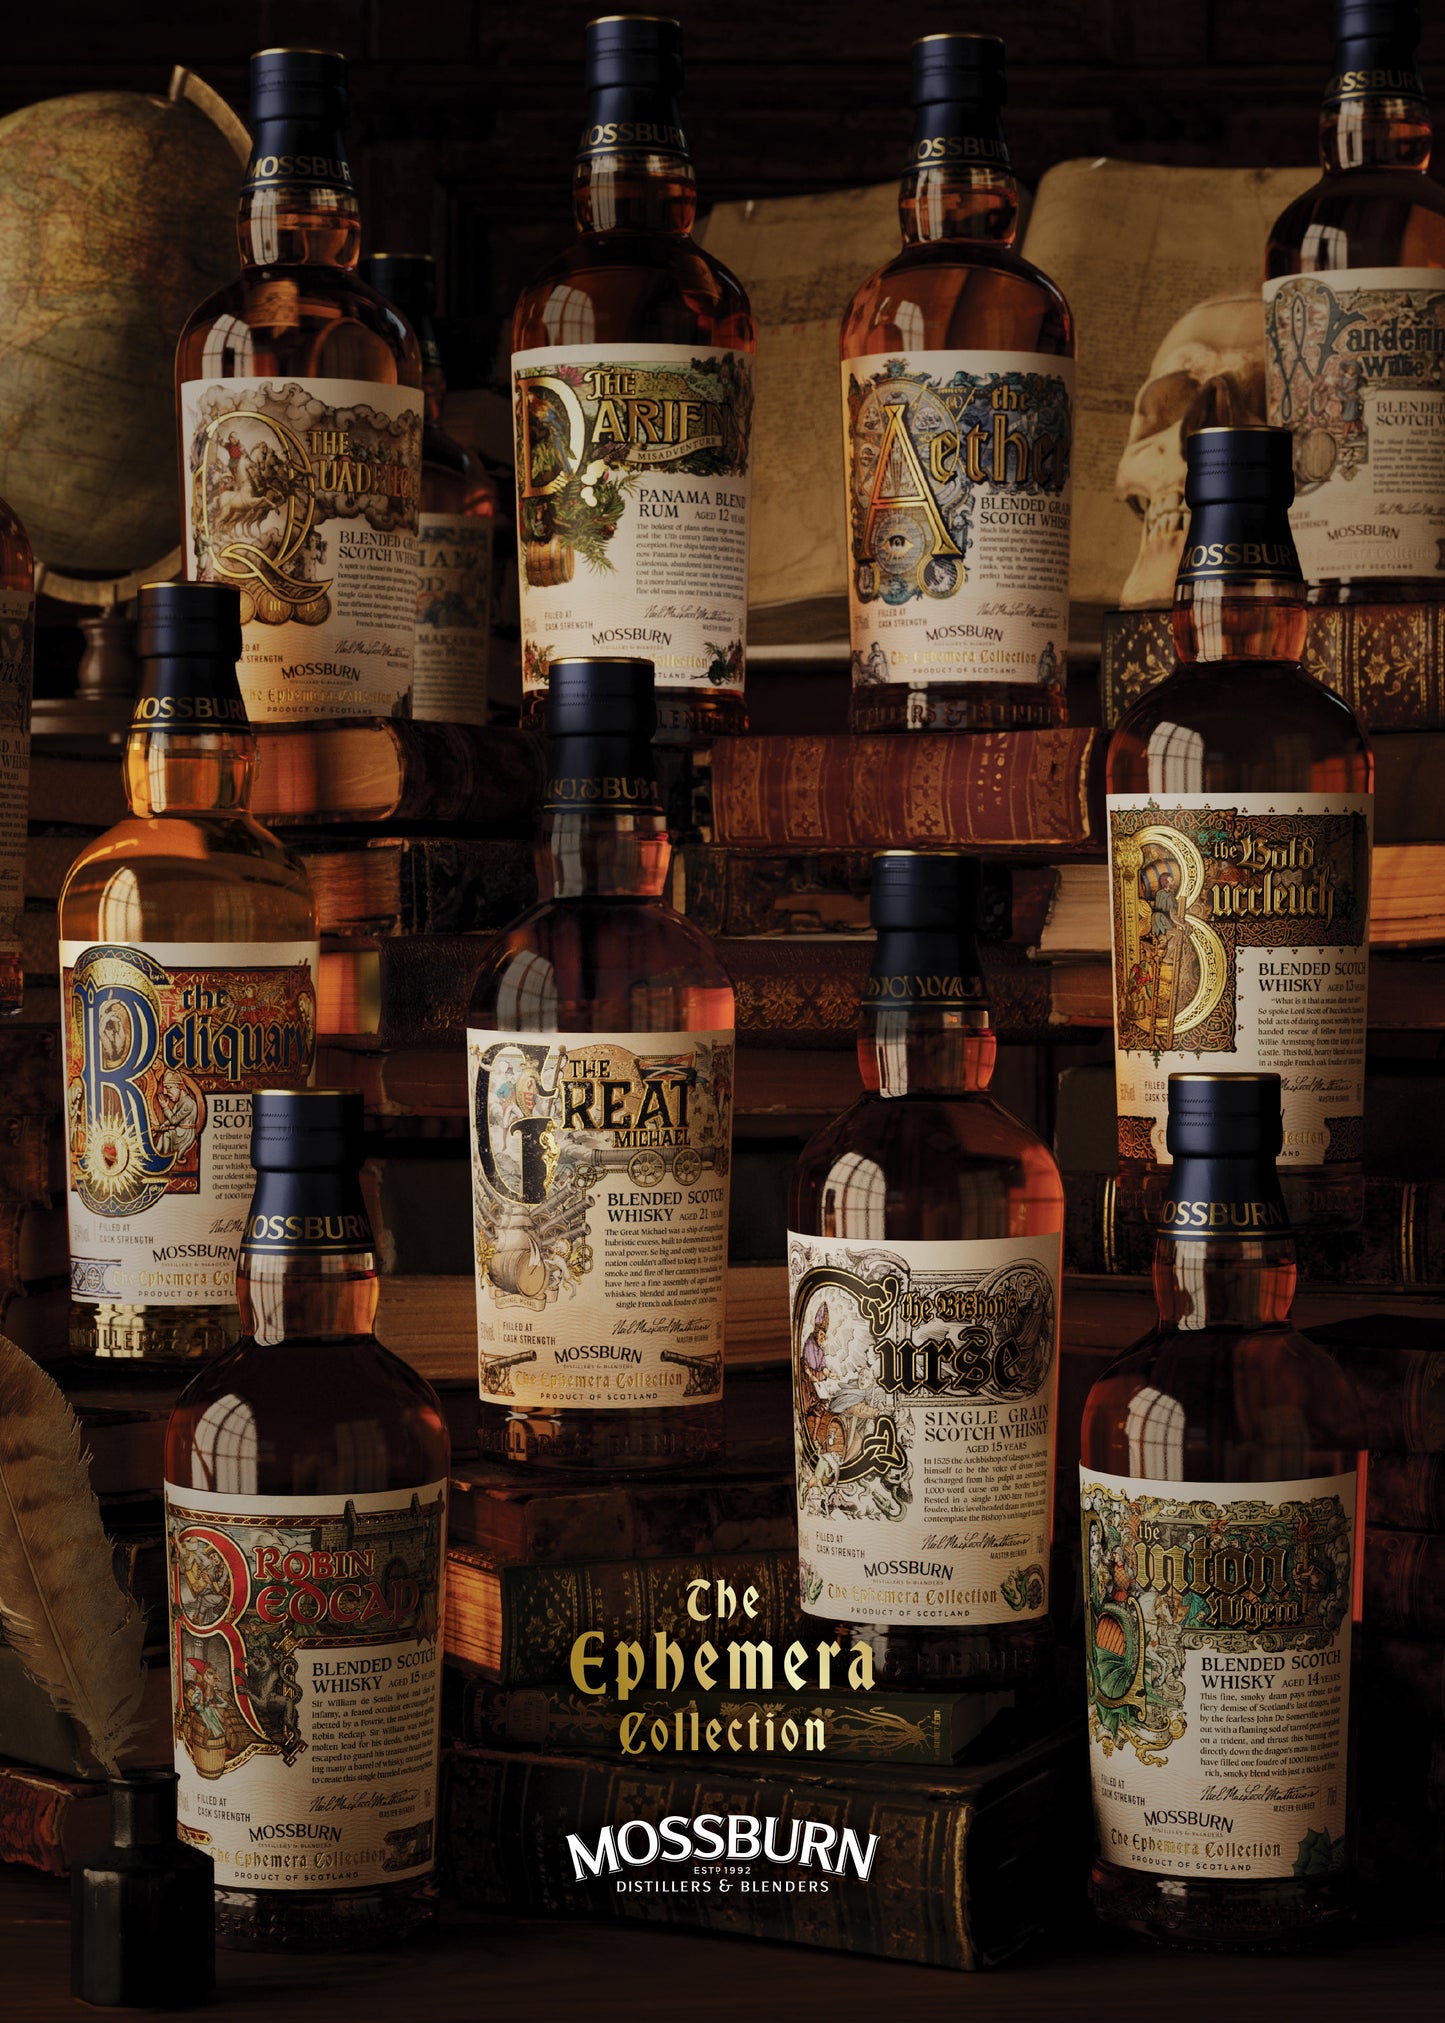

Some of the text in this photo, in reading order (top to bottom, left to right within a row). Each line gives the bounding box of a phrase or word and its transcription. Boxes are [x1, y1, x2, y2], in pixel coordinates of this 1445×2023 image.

[585, 370, 635, 399] THE
[992, 386, 1029, 410] the
[1376, 414, 1432, 426] SCOTCH
[308, 431, 349, 455] THE
[638, 437, 717, 462] MISADVENTURE
[639, 489, 710, 505] PANAMA
[981, 498, 1045, 512] BLENDED
[639, 506, 729, 522] RUM AGED 12
[980, 513, 1036, 525] SCOTCH
[340, 532, 400, 547] BLENDED
[1327, 524, 1400, 540] MOSSBURN
[338, 546, 392, 561] SCOTCH
[559, 622, 593, 630] STRENGTH
[894, 618, 927, 627] STRENGTH
[593, 629, 672, 646] MOSSBURN
[926, 625, 1004, 642] MOSSBURN
[282, 663, 360, 681] MOSSBURN
[1214, 839, 1238, 859] the
[1259, 962, 1330, 976] BLENDED
[1259, 979, 1322, 992] WHISKY
[183, 986, 228, 1010] the
[1269, 1008, 1289, 1016] spoke
[569, 1059, 610, 1079] THE
[214, 1099, 253, 1112] BLEN
[213, 1115, 253, 1128] SCOT
[613, 1130, 691, 1148] MICHAEL
[608, 1189, 723, 1206] BLENDED SCOTCH
[608, 1208, 674, 1222] WHISKY
[699, 1211, 709, 1220] 21
[99, 1223, 120, 1231] FILLED
[117, 1237, 154, 1245] STRENGTH
[153, 1245, 237, 1262] MOSSBURN
[214, 1269, 235, 1286] Col
[139, 1290, 179, 1298] PRODUCT
[205, 1290, 236, 1298] SCOTL
[901, 1294, 934, 1324] the
[503, 1322, 523, 1331] FILLED
[503, 1334, 555, 1345] CASK STRENGTH
[555, 1346, 642, 1363] MOSSBURN
[616, 1372, 682, 1389] Collection
[541, 1392, 584, 1400] PRODUCT
[608, 1392, 658, 1400] SCOTLAND
[924, 1404, 1048, 1425] SINGLE GRAIN
[924, 1421, 1048, 1442] SCOTCH WHISKY
[966, 1442, 1027, 1453] AGED 15 YEARS
[924, 1477, 963, 1485] discharged
[816, 1532, 842, 1542] FILLED AT
[1139, 1522, 1159, 1541] the
[817, 1544, 865, 1558] CASK STRENGTH
[254, 1547, 376, 1580] ROBIN
[864, 1561, 953, 1579] MOSSBURN
[828, 1583, 996, 1605] The Collection
[851, 1607, 893, 1616] PRODUCT
[917, 1609, 970, 1617] SCOTLAND
[313, 1647, 436, 1676] BLENDED SCOTCH
[1201, 1651, 1341, 1671] BLENDED SCOTCH
[313, 1672, 420, 1694] WHISKY AGED 15
[1201, 1674, 1319, 1689] WHISKY AGED 14
[1241, 1693, 1265, 1701] smoky
[197, 1794, 226, 1806] FILLED AT
[1116, 1791, 1145, 1806] STRENGTH
[198, 1807, 250, 1822] CASK STRENGTH
[1144, 1811, 1233, 1833] MOSSBURN
[249, 1825, 341, 1843] MOSSBURN
[1111, 1829, 1128, 1846] The
[1133, 1833, 1199, 1857] Ephemera
[1205, 1842, 1281, 1857] Collection
[236, 1849, 385, 1868] Ephemera Collection
[1132, 1855, 1251, 1872] PRODUCT OF SCOTLAND
[235, 1871, 280, 1880] PRODUCT
[305, 1872, 358, 1880] SCOTLAND
